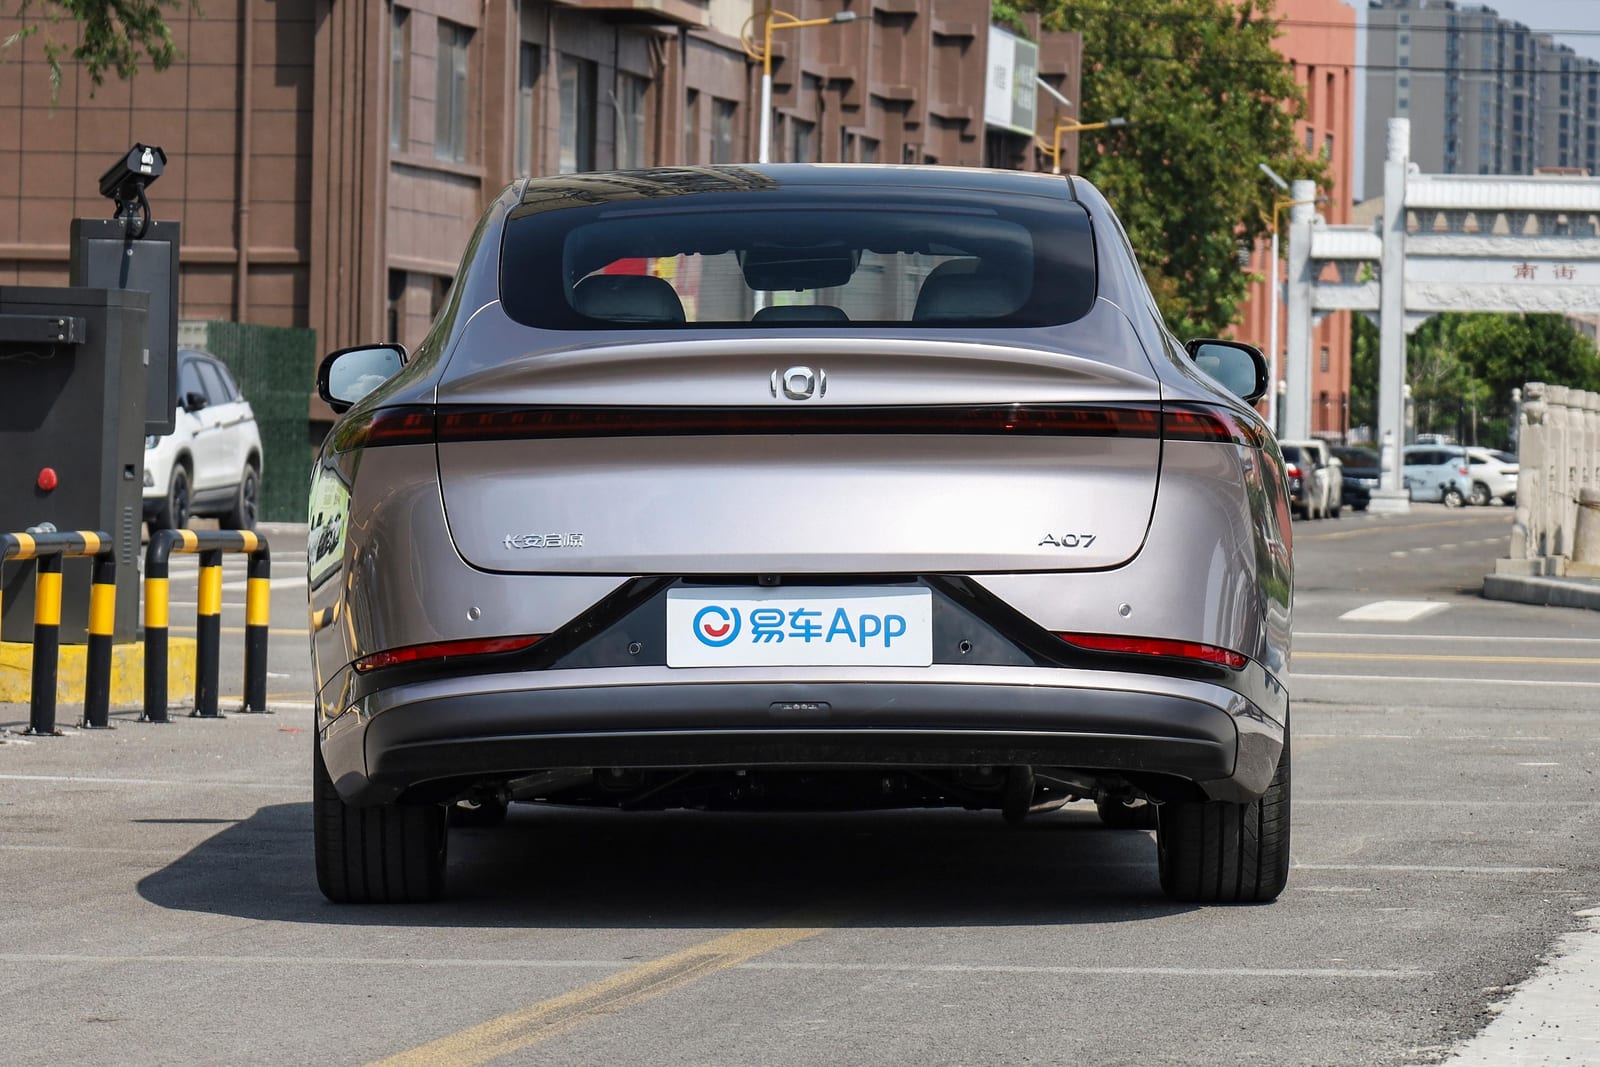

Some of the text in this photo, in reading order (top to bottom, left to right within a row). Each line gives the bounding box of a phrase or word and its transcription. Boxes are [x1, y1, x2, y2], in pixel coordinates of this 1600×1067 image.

[1512, 262, 1577, 280] 南街
[503, 533, 583, 550] 长安启源
[1038, 533, 1096, 548] A07
[750, 607, 907, 648] 易车App
